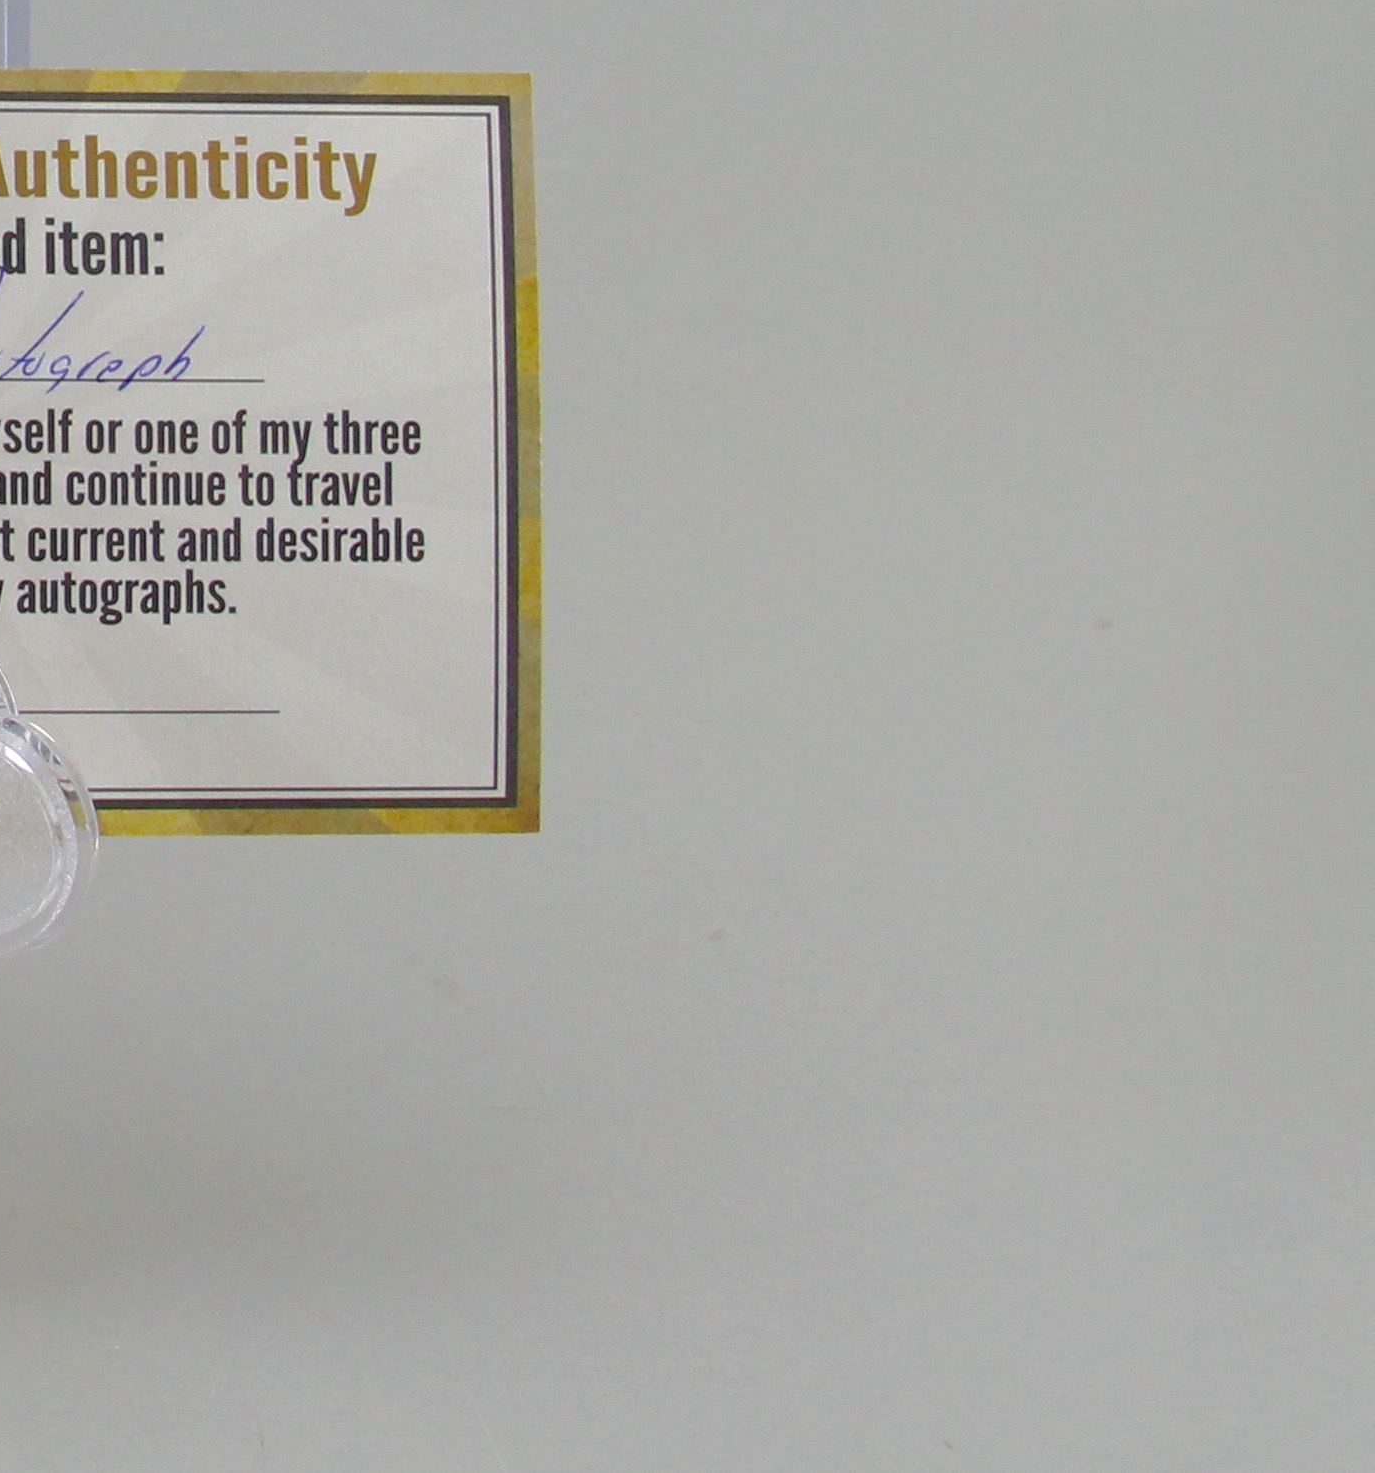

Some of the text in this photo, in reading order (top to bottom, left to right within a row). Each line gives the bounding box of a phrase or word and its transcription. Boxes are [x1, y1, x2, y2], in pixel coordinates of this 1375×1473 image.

[44, 216, 165, 276] item:
[84, 419, 124, 455] or
[134, 419, 199, 455] one
[211, 409, 248, 455] of
[259, 419, 312, 466] my
[322, 409, 422, 456] three
[65, 460, 227, 507] continue
[237, 463, 276, 508] to
[287, 461, 394, 507] travel
[26, 520, 166, 563] current
[176, 517, 243, 563] and
[255, 517, 426, 563] desirable
[16, 569, 238, 626] autographs.
